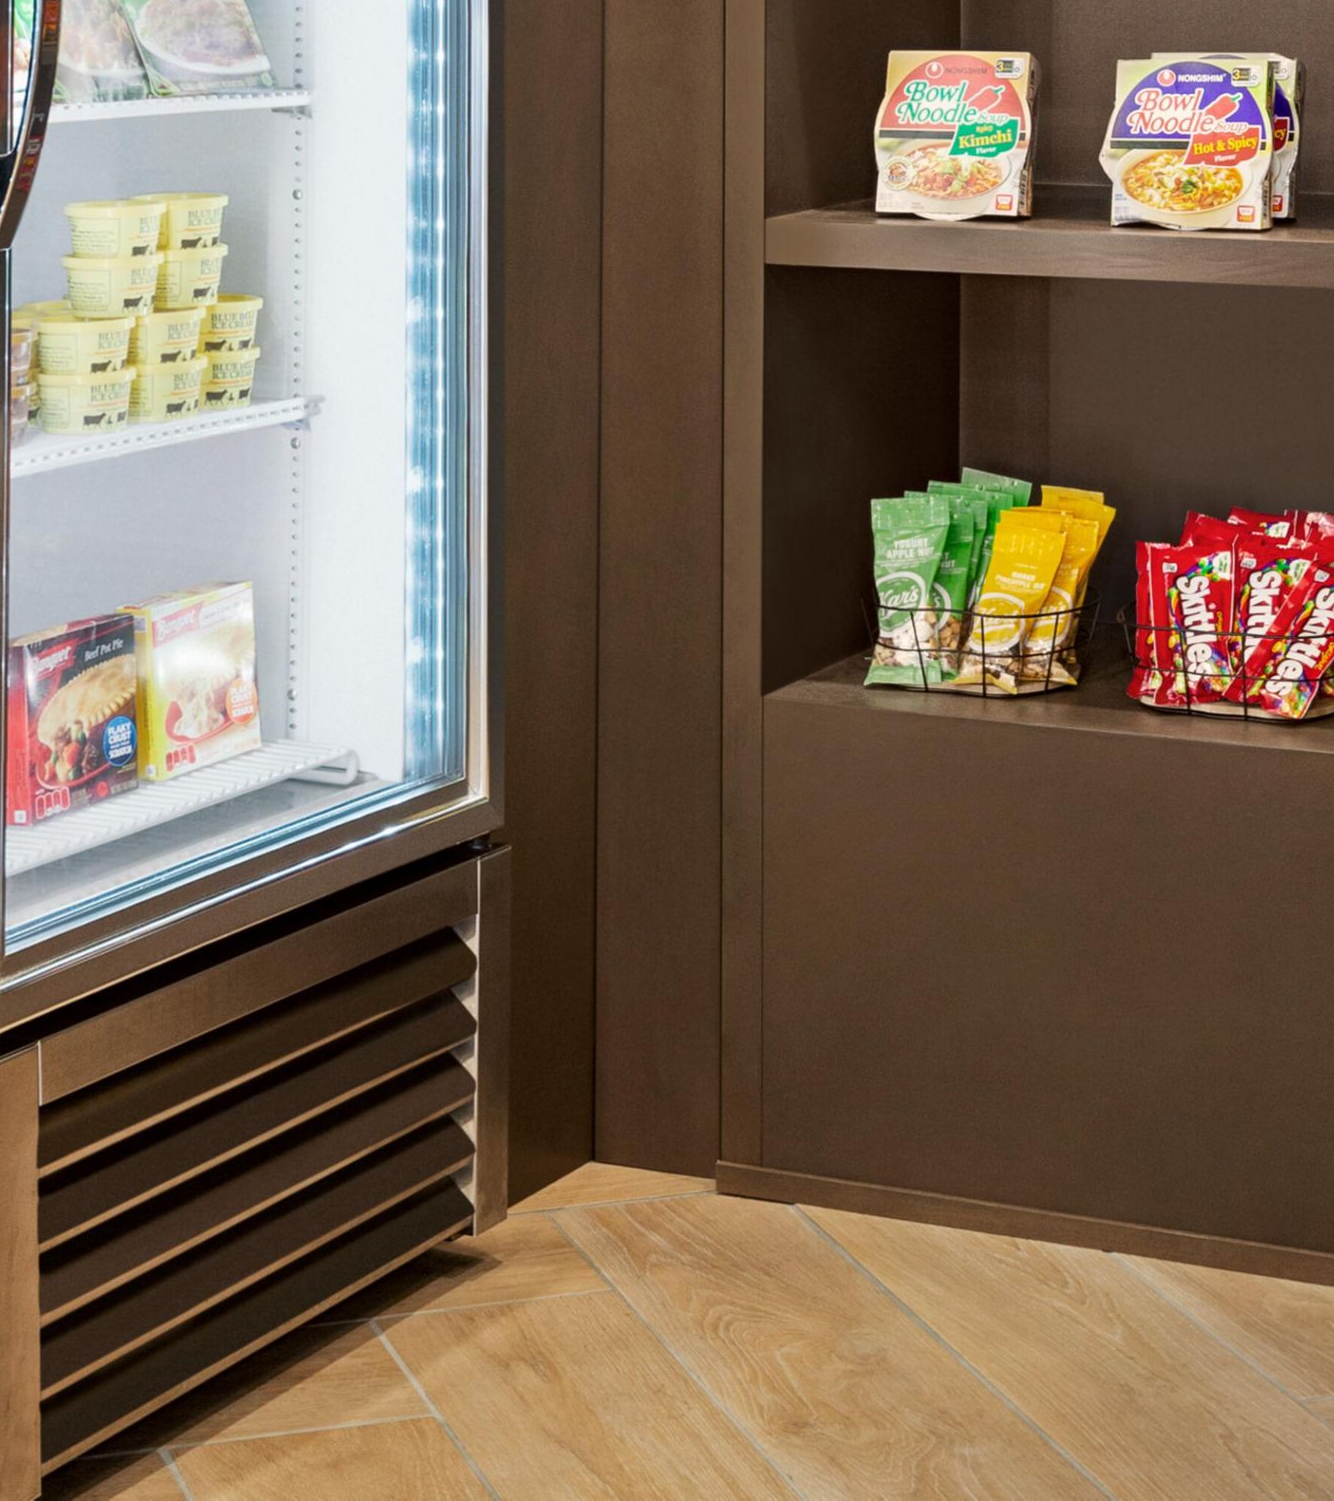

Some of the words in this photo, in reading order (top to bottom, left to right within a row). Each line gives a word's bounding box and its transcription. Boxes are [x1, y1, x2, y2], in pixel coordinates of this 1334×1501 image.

[945, 66, 988, 76] NONGSHIM
[1177, 73, 1224, 83] NONGSHIM
[905, 80, 967, 102] Bowl
[1135, 89, 1203, 111] Bowl
[896, 102, 977, 124] Noodle
[977, 112, 1008, 124] Soup
[1127, 111, 1213, 134] Noodle
[1213, 121, 1247, 133] Soup
[959, 130, 1013, 148] Kimchi
[1192, 141, 1213, 155] Hot
[1215, 139, 1225, 151] &
[1226, 135, 1258, 153] Spicy
[975, 146, 997, 155] Flavor
[1214, 154, 1237, 162] Flavor
[886, 547, 915, 559] APPLE
[917, 546, 935, 556] NUT
[894, 538, 929, 549] YOGURT
[1176, 575, 1217, 682] Skittles
[84, 644, 100, 661] Beef
[112, 638, 124, 651] Pie
